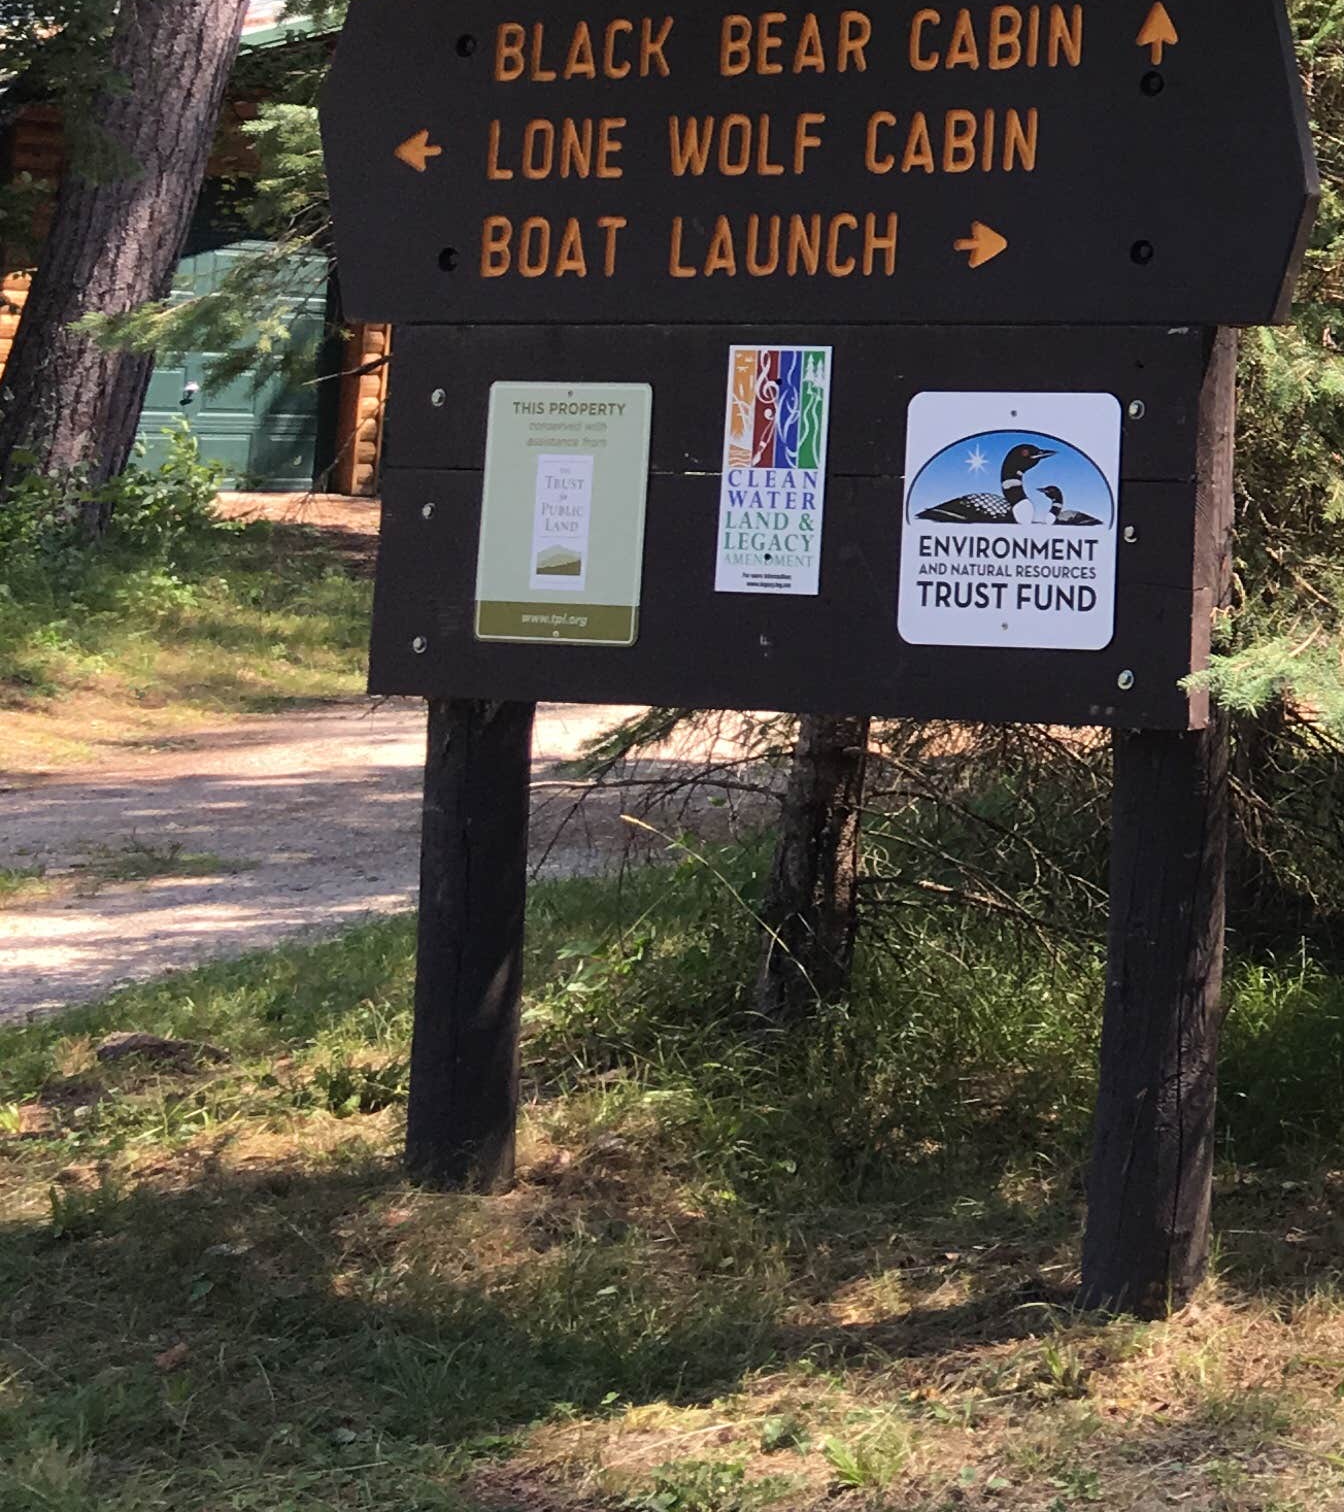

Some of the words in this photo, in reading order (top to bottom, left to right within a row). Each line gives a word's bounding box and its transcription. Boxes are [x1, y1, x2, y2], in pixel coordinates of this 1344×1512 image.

[495, 16, 674, 82] BLACK
[719, 9, 872, 77] BEAR
[909, 4, 1083, 71] CABIN
[487, 117, 627, 179] LONE
[668, 112, 826, 176] WOLF
[865, 107, 1038, 174] CABIN
[480, 215, 627, 278] BOAT
[669, 212, 898, 277] LAUNCH
[513, 401, 545, 415] THIS
[549, 402, 627, 416] PROPERTY
[727, 469, 818, 488] CLEAN
[727, 490, 816, 510] WATER
[726, 511, 789, 530] LAND
[798, 513, 814, 531] &
[724, 532, 815, 552] LEGACY
[919, 535, 1099, 561] ENVIRONMENT
[918, 563, 947, 576] AND
[951, 563, 1012, 578] NATURAL
[1015, 565, 1097, 580] RESOURCES
[916, 580, 1008, 609] TRUST
[1016, 583, 1097, 612] FUND
[521, 613, 588, 627] www.tpl.org
